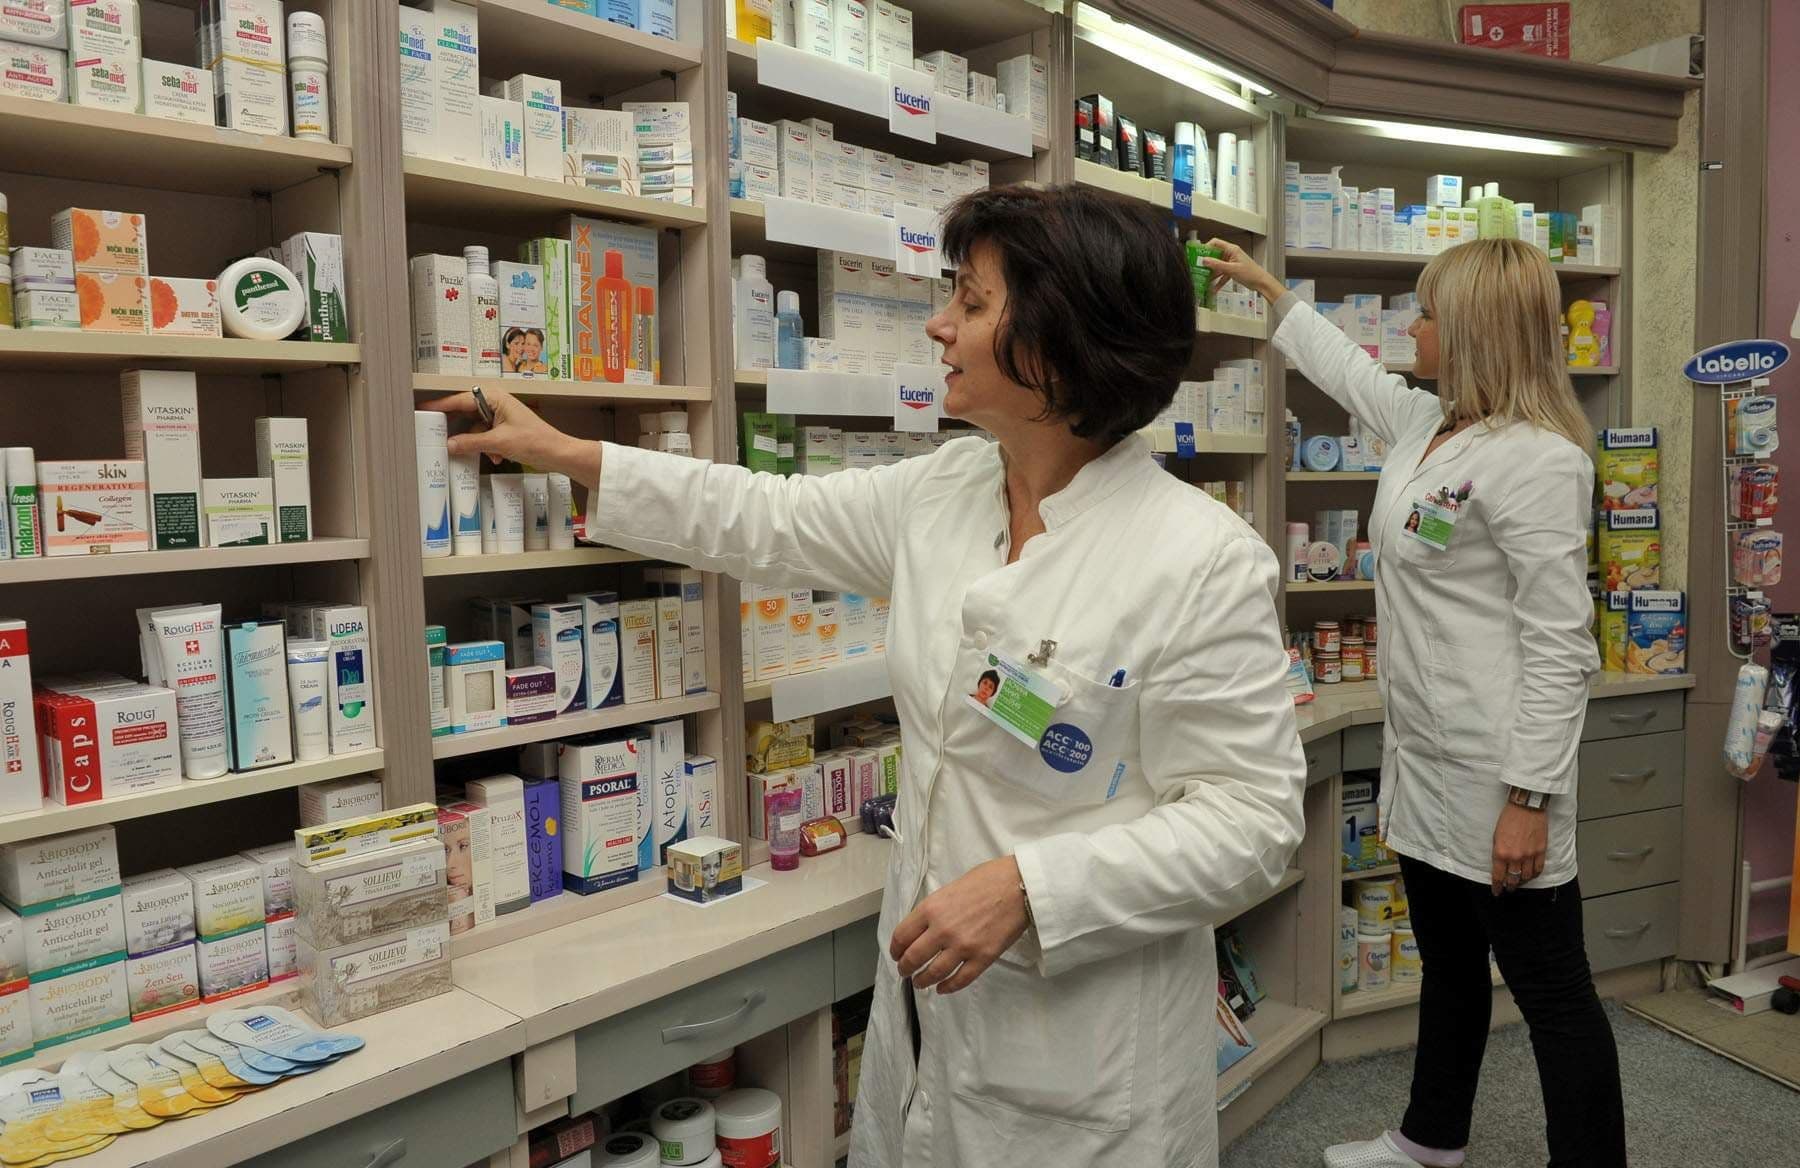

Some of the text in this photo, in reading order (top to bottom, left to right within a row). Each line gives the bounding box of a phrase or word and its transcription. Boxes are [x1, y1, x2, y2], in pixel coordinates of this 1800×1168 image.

[239, 19, 269, 35] sebamed
[443, 27, 471, 45] sebamed
[161, 74, 199, 94] sebamed
[894, 86, 930, 111] Eucerin
[1174, 191, 1193, 204] VICHY
[900, 226, 936, 248] Eucerin
[34, 251, 65, 260] FACE
[840, 256, 862, 269] Eucerin
[872, 261, 894, 273] Eucerin
[440, 274, 464, 286] Puzzle
[241, 280, 280, 296] panthenol
[41, 294, 72, 304] FACE
[576, 222, 593, 383] GRANEX
[609, 290, 620, 370] GRANEX
[1697, 352, 1775, 375] Labello
[900, 386, 934, 403] Eucerin
[147, 406, 191, 415] VITASKIN
[1177, 434, 1196, 444] VICHY
[1610, 432, 1651, 444] Humana
[57, 483, 135, 492] REGENERATIVE
[220, 491, 257, 499] VITASKIN
[12, 494, 35, 503] fresh
[98, 496, 132, 504] Collagen
[1613, 513, 1653, 525] Humana
[15, 506, 34, 556] halazon
[766, 600, 777, 611] 50
[330, 621, 364, 634] LIDERA
[797, 615, 807, 625] 50
[117, 709, 156, 723] ROUGJ
[1046, 729, 1091, 752] ACC 100
[70, 716, 93, 792] Caps
[1043, 740, 1067, 754] ACC
[1069, 749, 1088, 762] 200
[594, 754, 625, 767] DERMA
[594, 761, 626, 776] MEDICA
[589, 779, 631, 796] PSORAL
[661, 768, 676, 829] Atopik
[699, 789, 713, 829] NiSal
[1345, 815, 1356, 843] 1
[529, 791, 543, 897] EKCEMOL
[36, 857, 103, 880] Anticelulit gel
[362, 870, 401, 886] SOLLIEVO
[1383, 906, 1393, 920] 2
[141, 919, 159, 928] Extra
[42, 923, 109, 947] Anticelulit gel
[368, 945, 407, 964] SOLLIEVO
[209, 961, 224, 969] Green
[225, 958, 235, 966] Tea
[144, 975, 164, 988] Zen
[46, 989, 113, 1015] Anticelulit gel
[0, 1020, 14, 1034] gel
